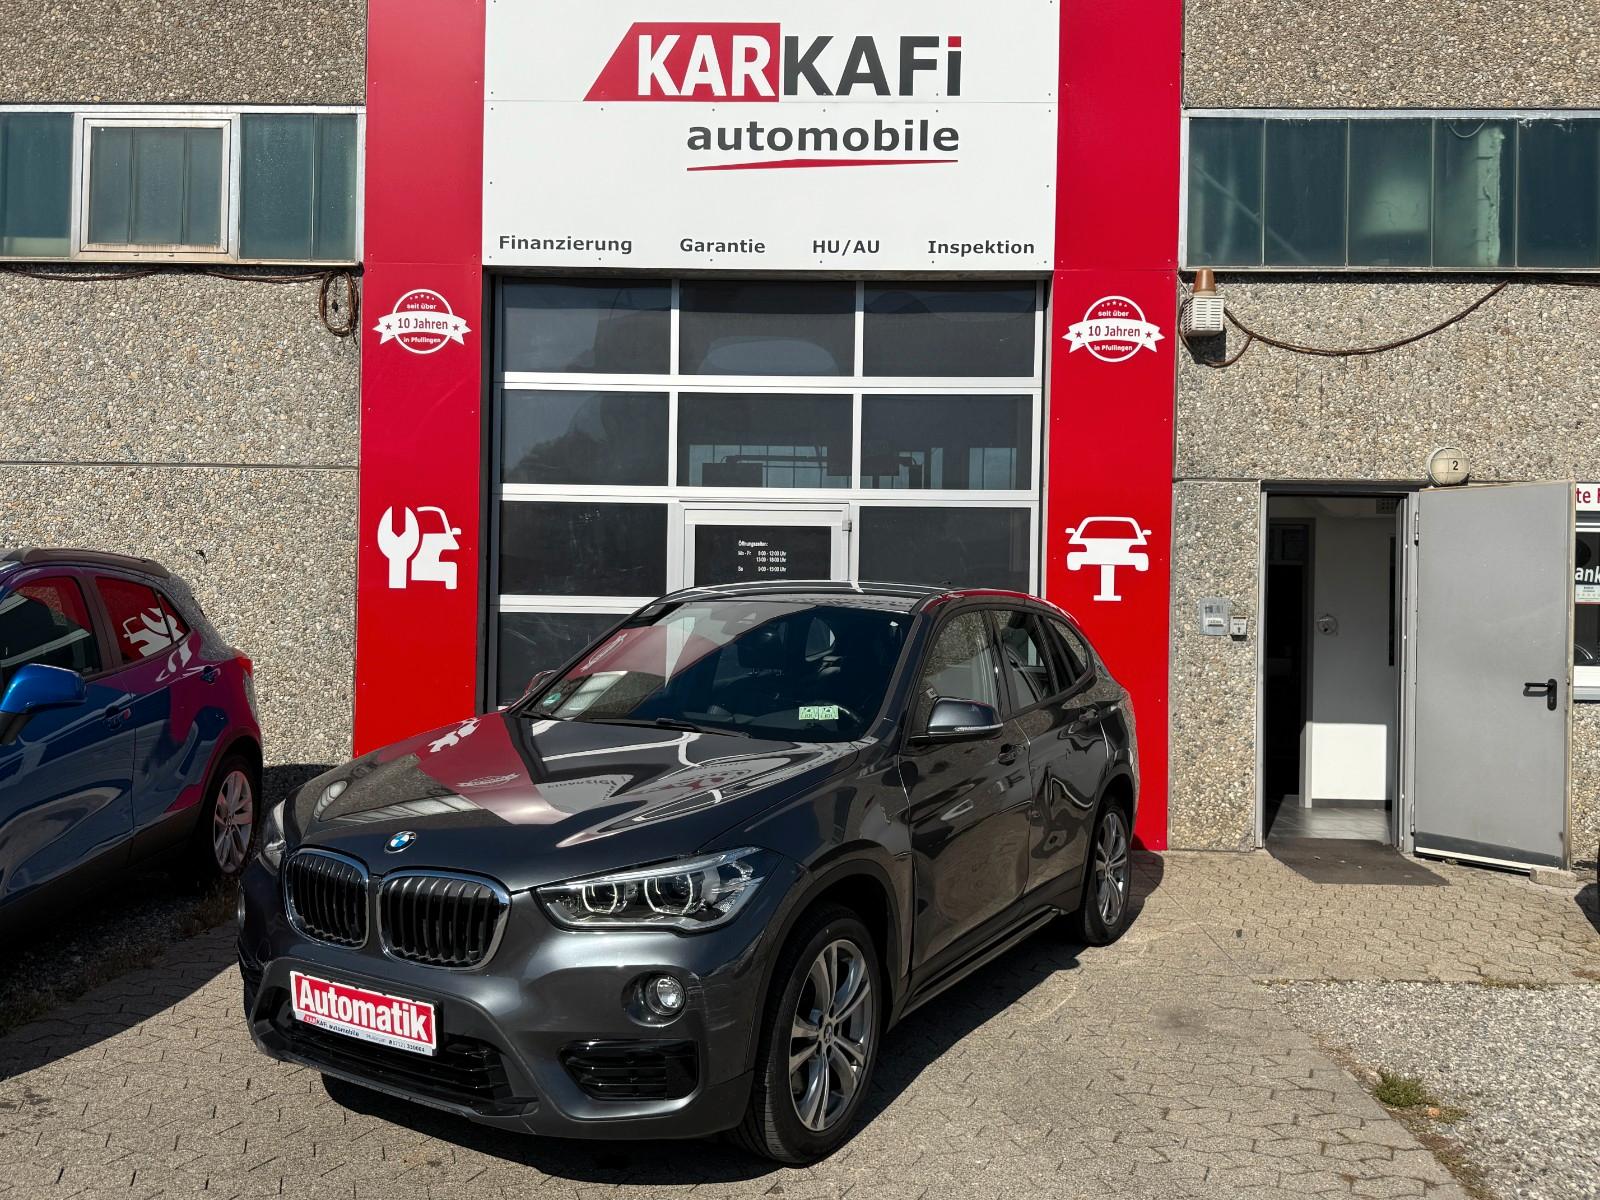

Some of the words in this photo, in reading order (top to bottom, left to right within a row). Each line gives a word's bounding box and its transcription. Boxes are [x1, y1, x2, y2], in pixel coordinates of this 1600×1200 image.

[686, 119, 959, 152] automobile
[499, 235, 632, 255] Finanzierung
[679, 238, 766, 254] Garantie
[813, 239, 880, 255] HU/AU
[927, 239, 1035, 255] Inspektion
[397, 317, 410, 329] 10
[413, 317, 449, 330] Jahren
[1088, 325, 1101, 337] 10
[1104, 325, 1140, 337] Jahren
[1101, 344, 1133, 352] Pfullingen
[1452, 460, 1459, 471] 2
[299, 978, 429, 1042] Automatik
